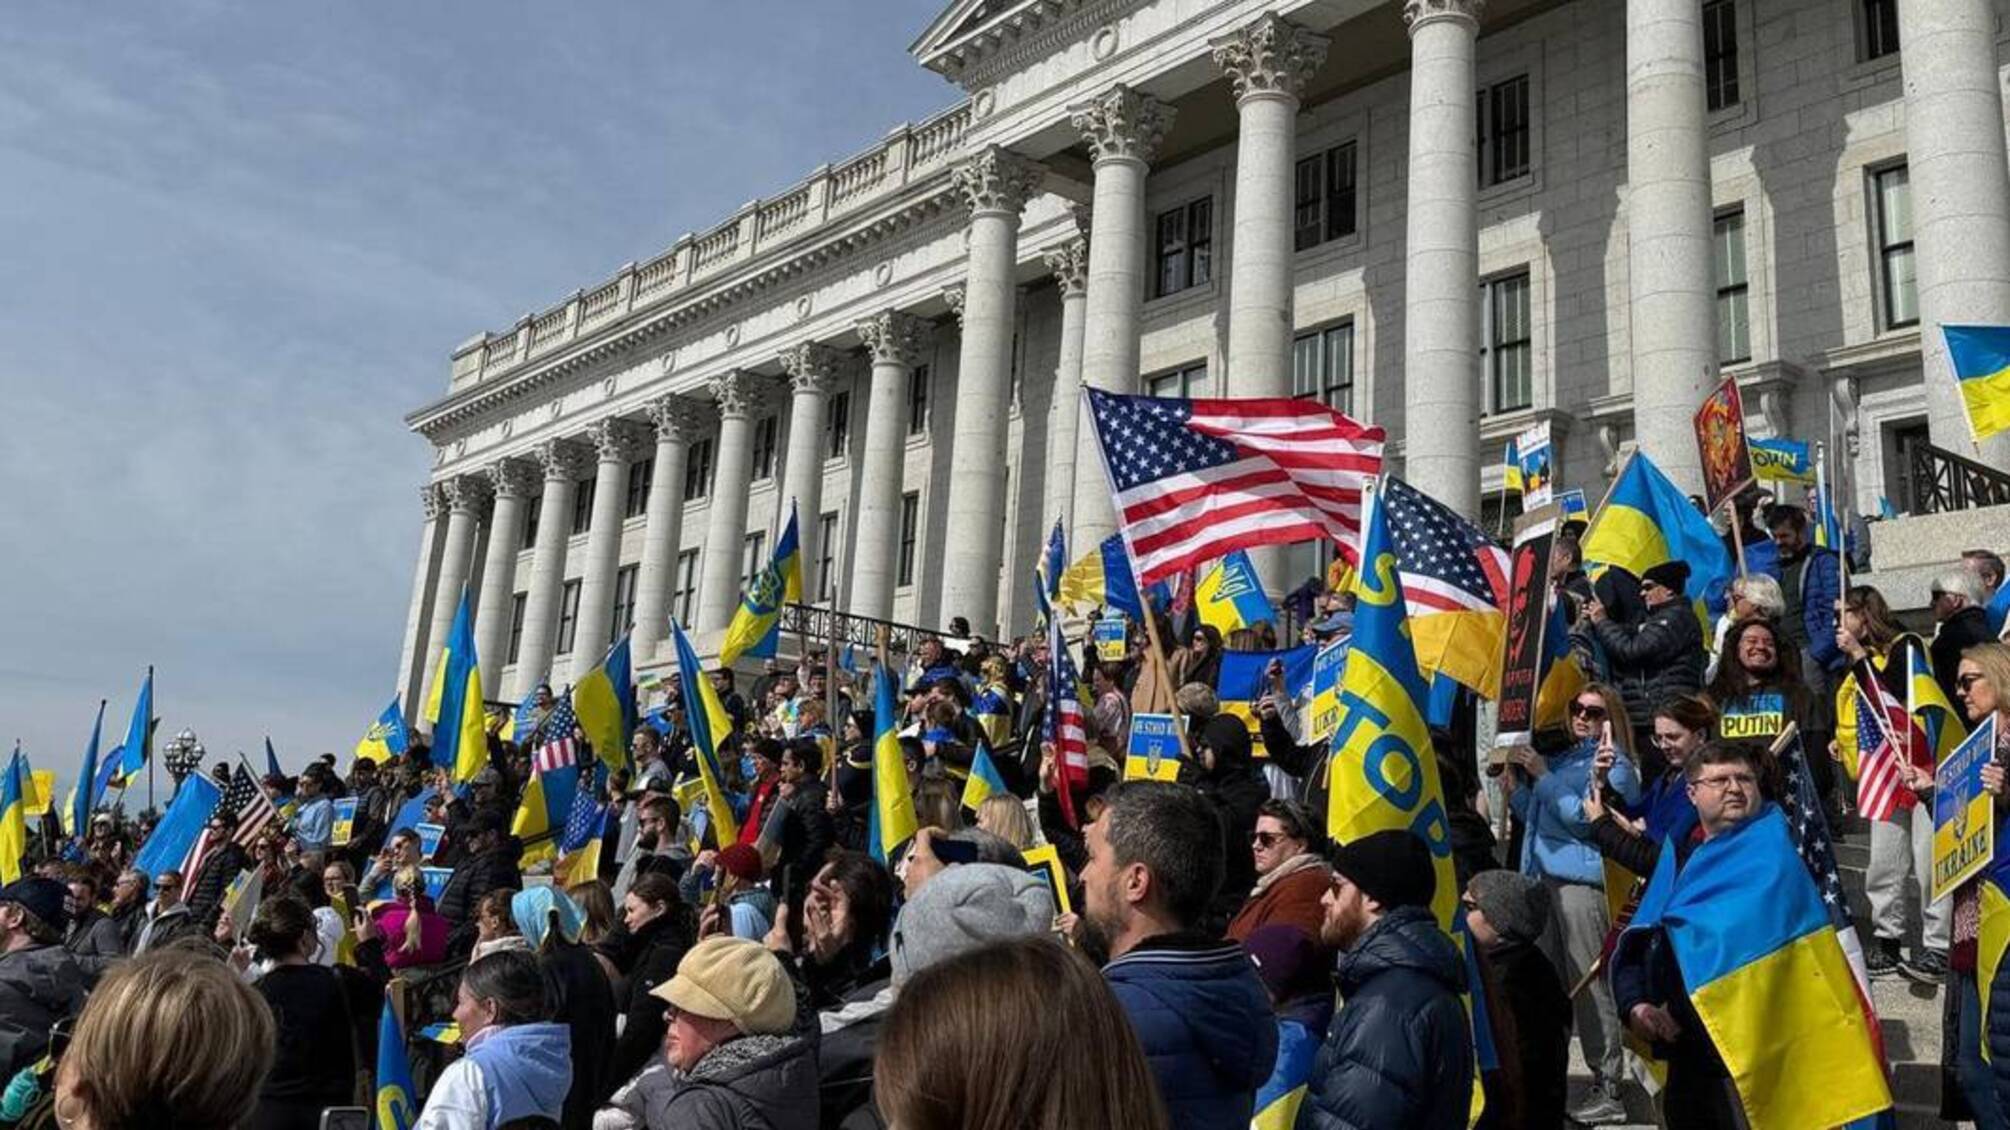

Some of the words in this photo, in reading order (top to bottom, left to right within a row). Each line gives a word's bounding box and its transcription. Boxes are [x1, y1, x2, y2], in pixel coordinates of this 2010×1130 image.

[1331, 552, 1452, 860] STOP
[1724, 714, 1779, 736] PUTIN
[1934, 825, 1987, 889] UKRAINE
